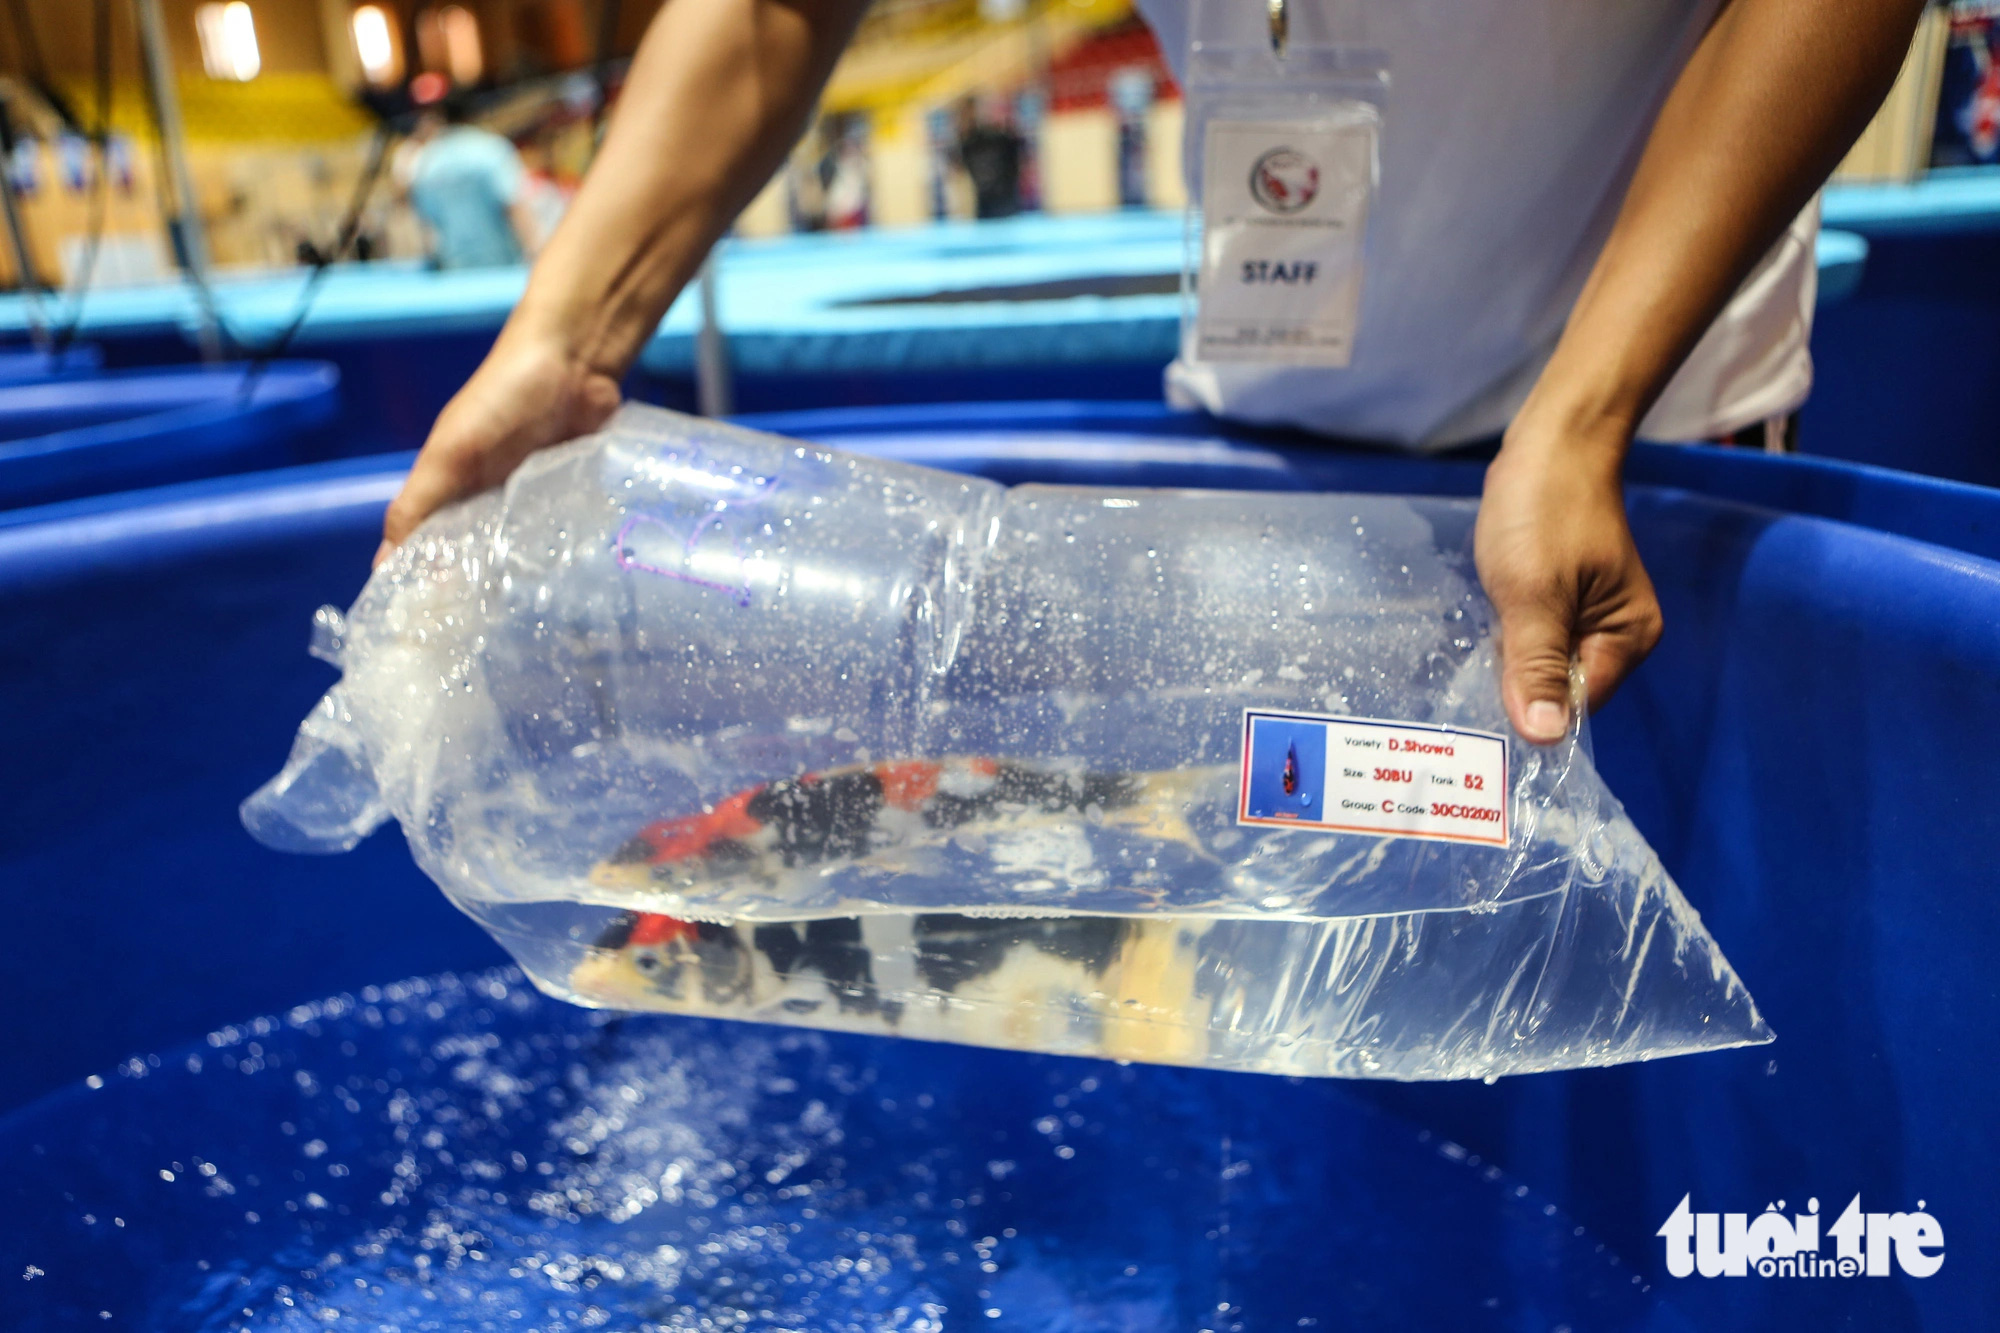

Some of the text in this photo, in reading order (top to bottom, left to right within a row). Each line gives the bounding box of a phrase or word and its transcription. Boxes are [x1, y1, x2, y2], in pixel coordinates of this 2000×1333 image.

[1241, 259, 1319, 284] STAFF
[1343, 767, 1484, 790] Size: 30BU Tank: 52
[1341, 799, 1501, 823] Group: C Code: 30C02007
